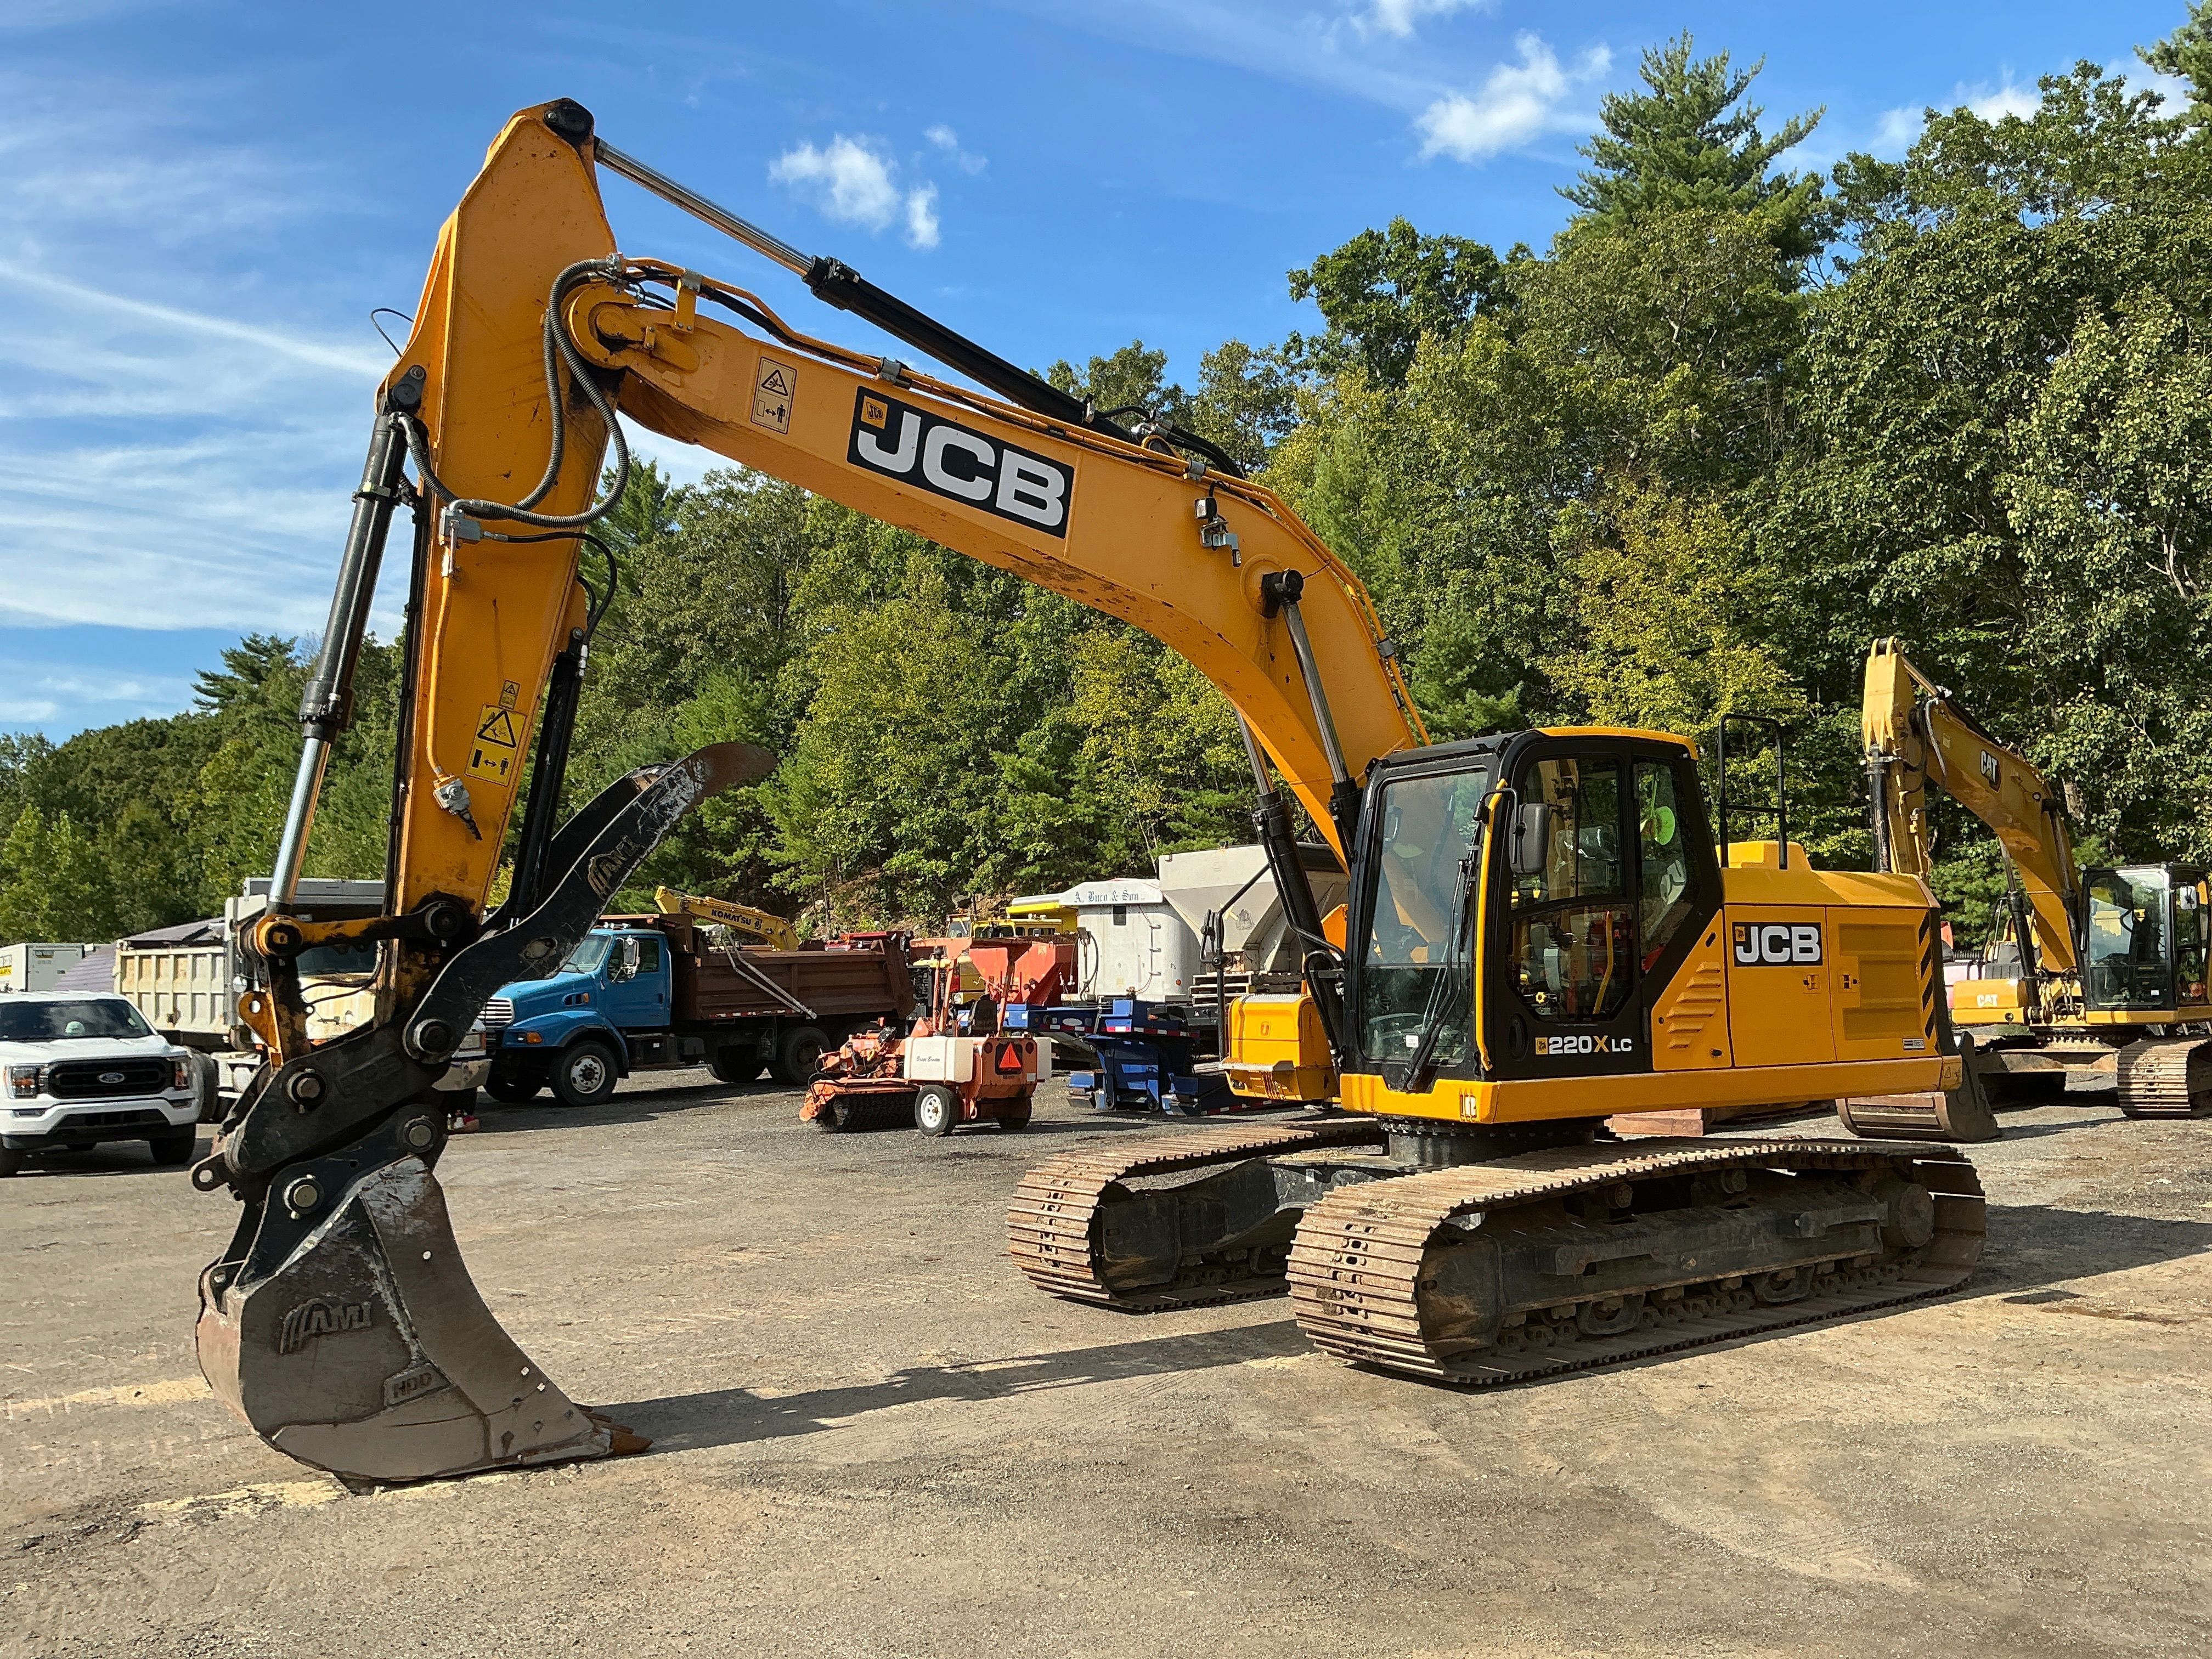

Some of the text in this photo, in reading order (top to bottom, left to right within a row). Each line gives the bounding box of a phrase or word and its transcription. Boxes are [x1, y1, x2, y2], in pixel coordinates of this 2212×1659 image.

[868, 403, 883, 419] JCB
[857, 410, 1065, 526] JCB
[1981, 751, 1997, 782] CAT
[1074, 891, 1084, 902] A.
[1111, 890, 1119, 901] &
[1122, 890, 1139, 901] Son
[711, 909, 752, 925] KOMATSU
[1736, 926, 1820, 963] JCB
[1977, 994, 1997, 1007] CAT
[1549, 1035, 1609, 1054] 220X
[1612, 1039, 1632, 1052] LC
